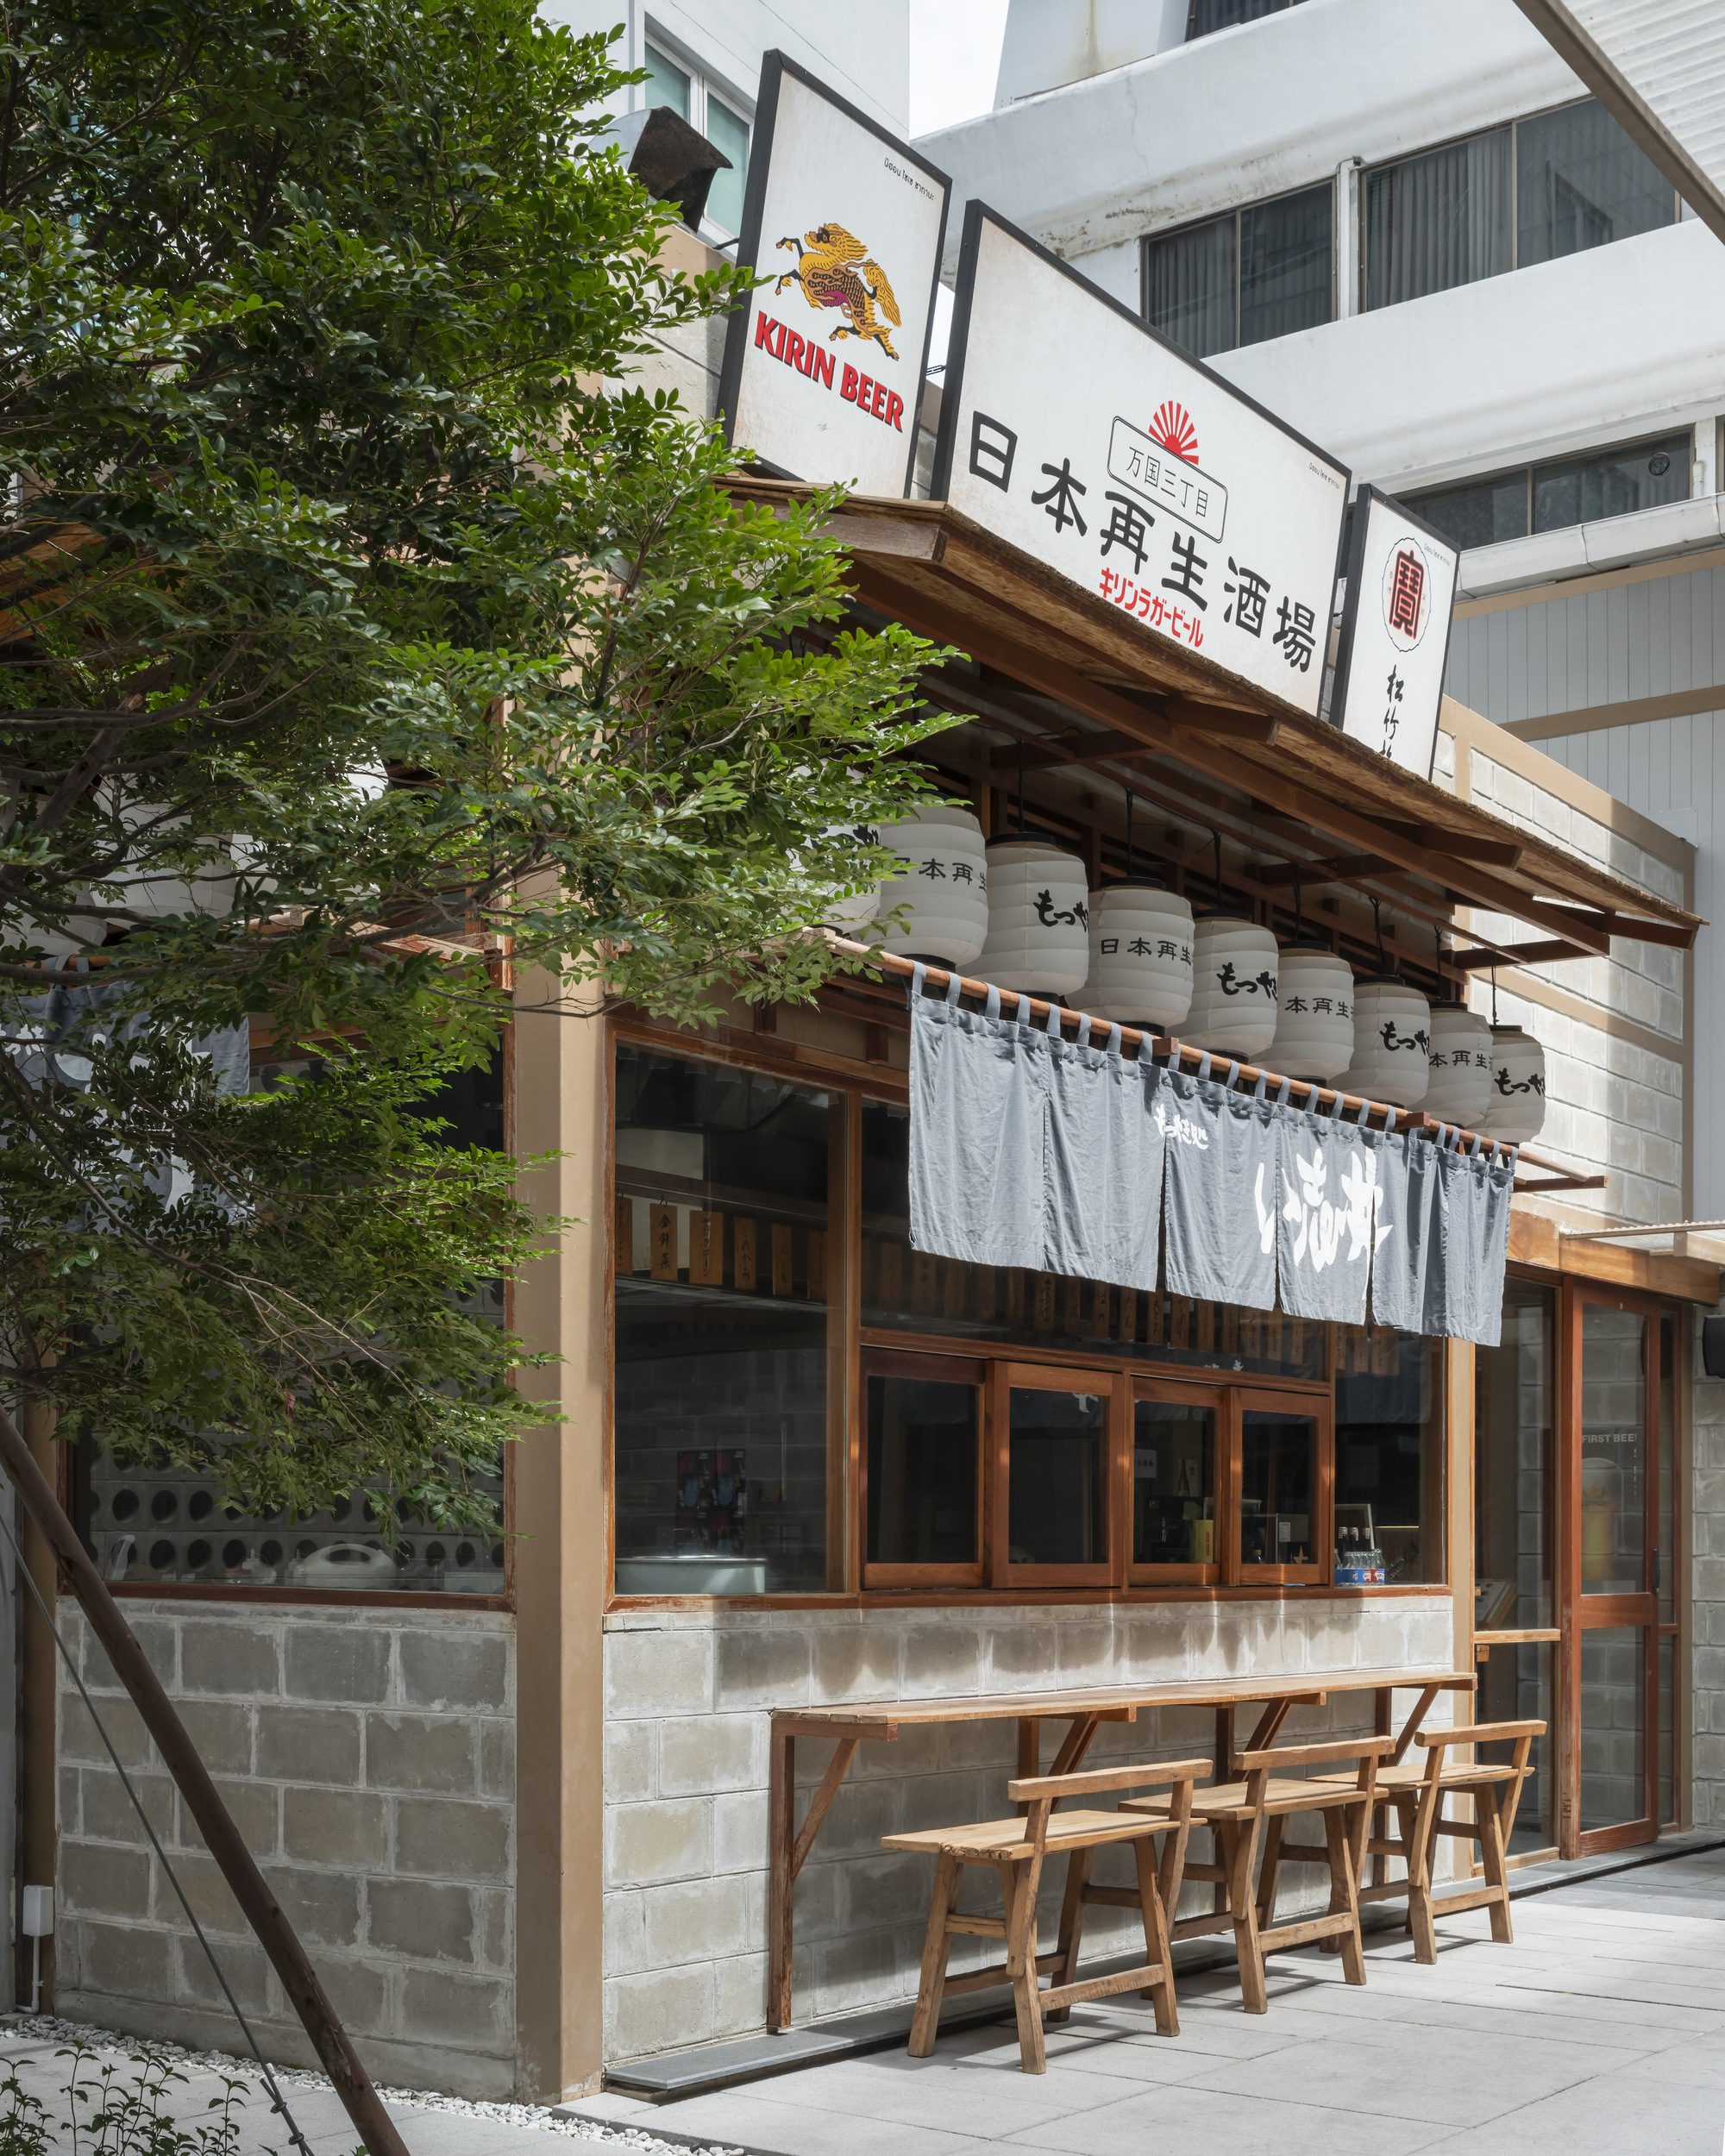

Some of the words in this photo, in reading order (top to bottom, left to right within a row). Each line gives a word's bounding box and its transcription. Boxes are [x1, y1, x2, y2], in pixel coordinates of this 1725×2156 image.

[755, 310, 836, 391] KIRIN
[841, 362, 904, 432] BEER
[1126, 445, 1209, 518] 万国三丁目
[969, 411, 1316, 673] 日本再生酒場
[1099, 567, 1204, 649] キリンラガービール
[1033, 889, 1089, 932] もつや
[1101, 937, 1194, 966] 日本再生
[1285, 996, 1353, 1018] 本再生
[1582, 1434, 1611, 1443] FIRST
[1614, 1433, 1637, 1443] BEE
